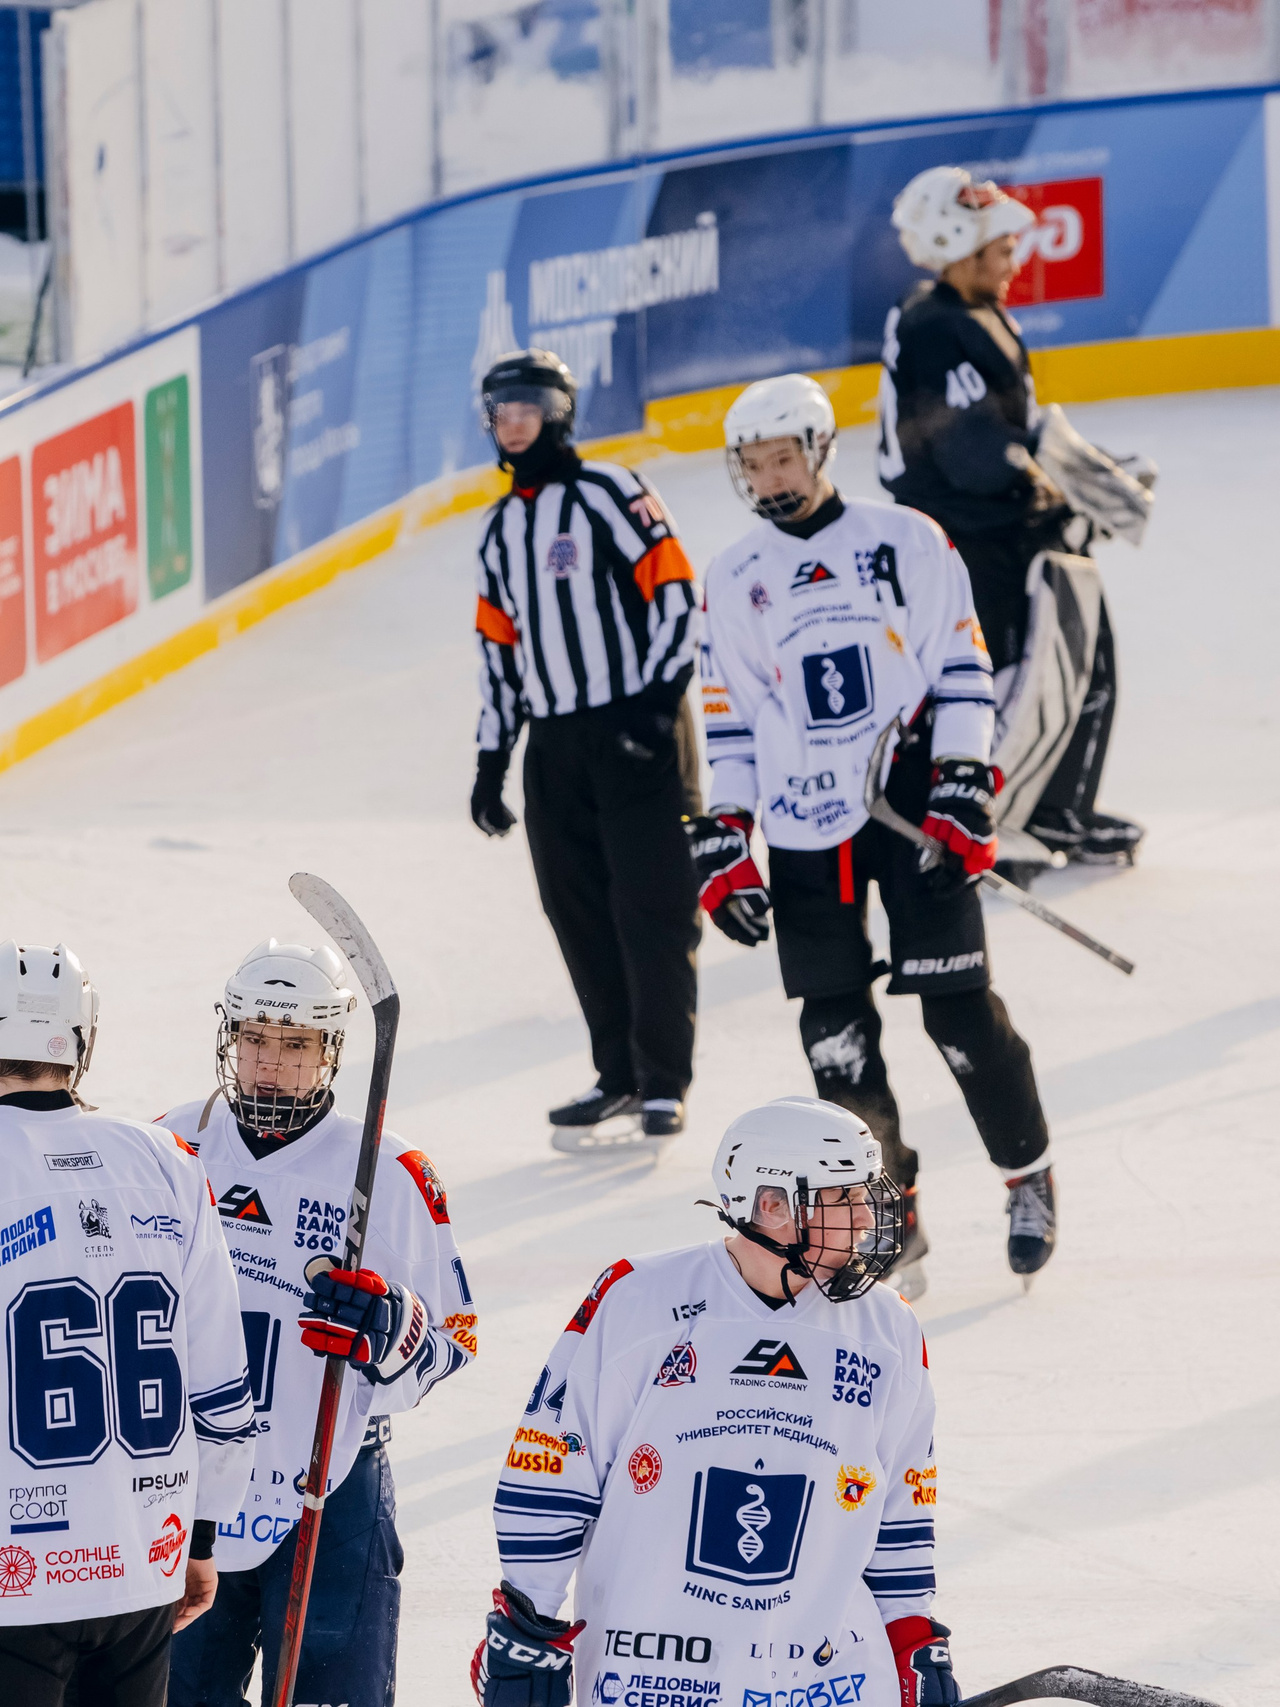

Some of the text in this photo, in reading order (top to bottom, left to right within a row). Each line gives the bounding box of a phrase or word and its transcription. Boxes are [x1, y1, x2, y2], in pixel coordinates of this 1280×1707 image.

[901, 950, 984, 976] BAUER
[254, 998, 299, 1011] BAUER
[755, 1166, 794, 1177] CCM
[298, 1197, 347, 1224] PANO
[235, 1223, 273, 1237] COMPANY
[296, 1214, 341, 1241] RAMA
[84, 1245, 114, 1254] СТЕПЬ
[293, 1232, 334, 1253] 360
[230, 1248, 277, 1271] ЙСКИЙ
[6, 1271, 181, 1470] 66
[729, 1378, 809, 1392] TRADING COMPANY
[832, 1384, 872, 1408] 360
[716, 1407, 814, 1429] РОССИЙСКИЙ
[514, 1426, 570, 1457] ghtseeing
[675, 1424, 839, 1457] УНИВЕРСИТЕТ МЕДИЦИНЫ
[9, 1484, 67, 1502] группа
[132, 1470, 189, 1493] IPSUM
[9, 1500, 68, 1521] СОФТ
[45, 1544, 121, 1567] СОЛНЦЕ
[46, 1562, 125, 1585] МОСКВЫ
[683, 1581, 791, 1611] HINC SANITAS
[488, 1627, 570, 1671] CCM
[605, 1629, 712, 1664] TECNO
[626, 1674, 721, 1696] ЛЕДОВЫЙ
